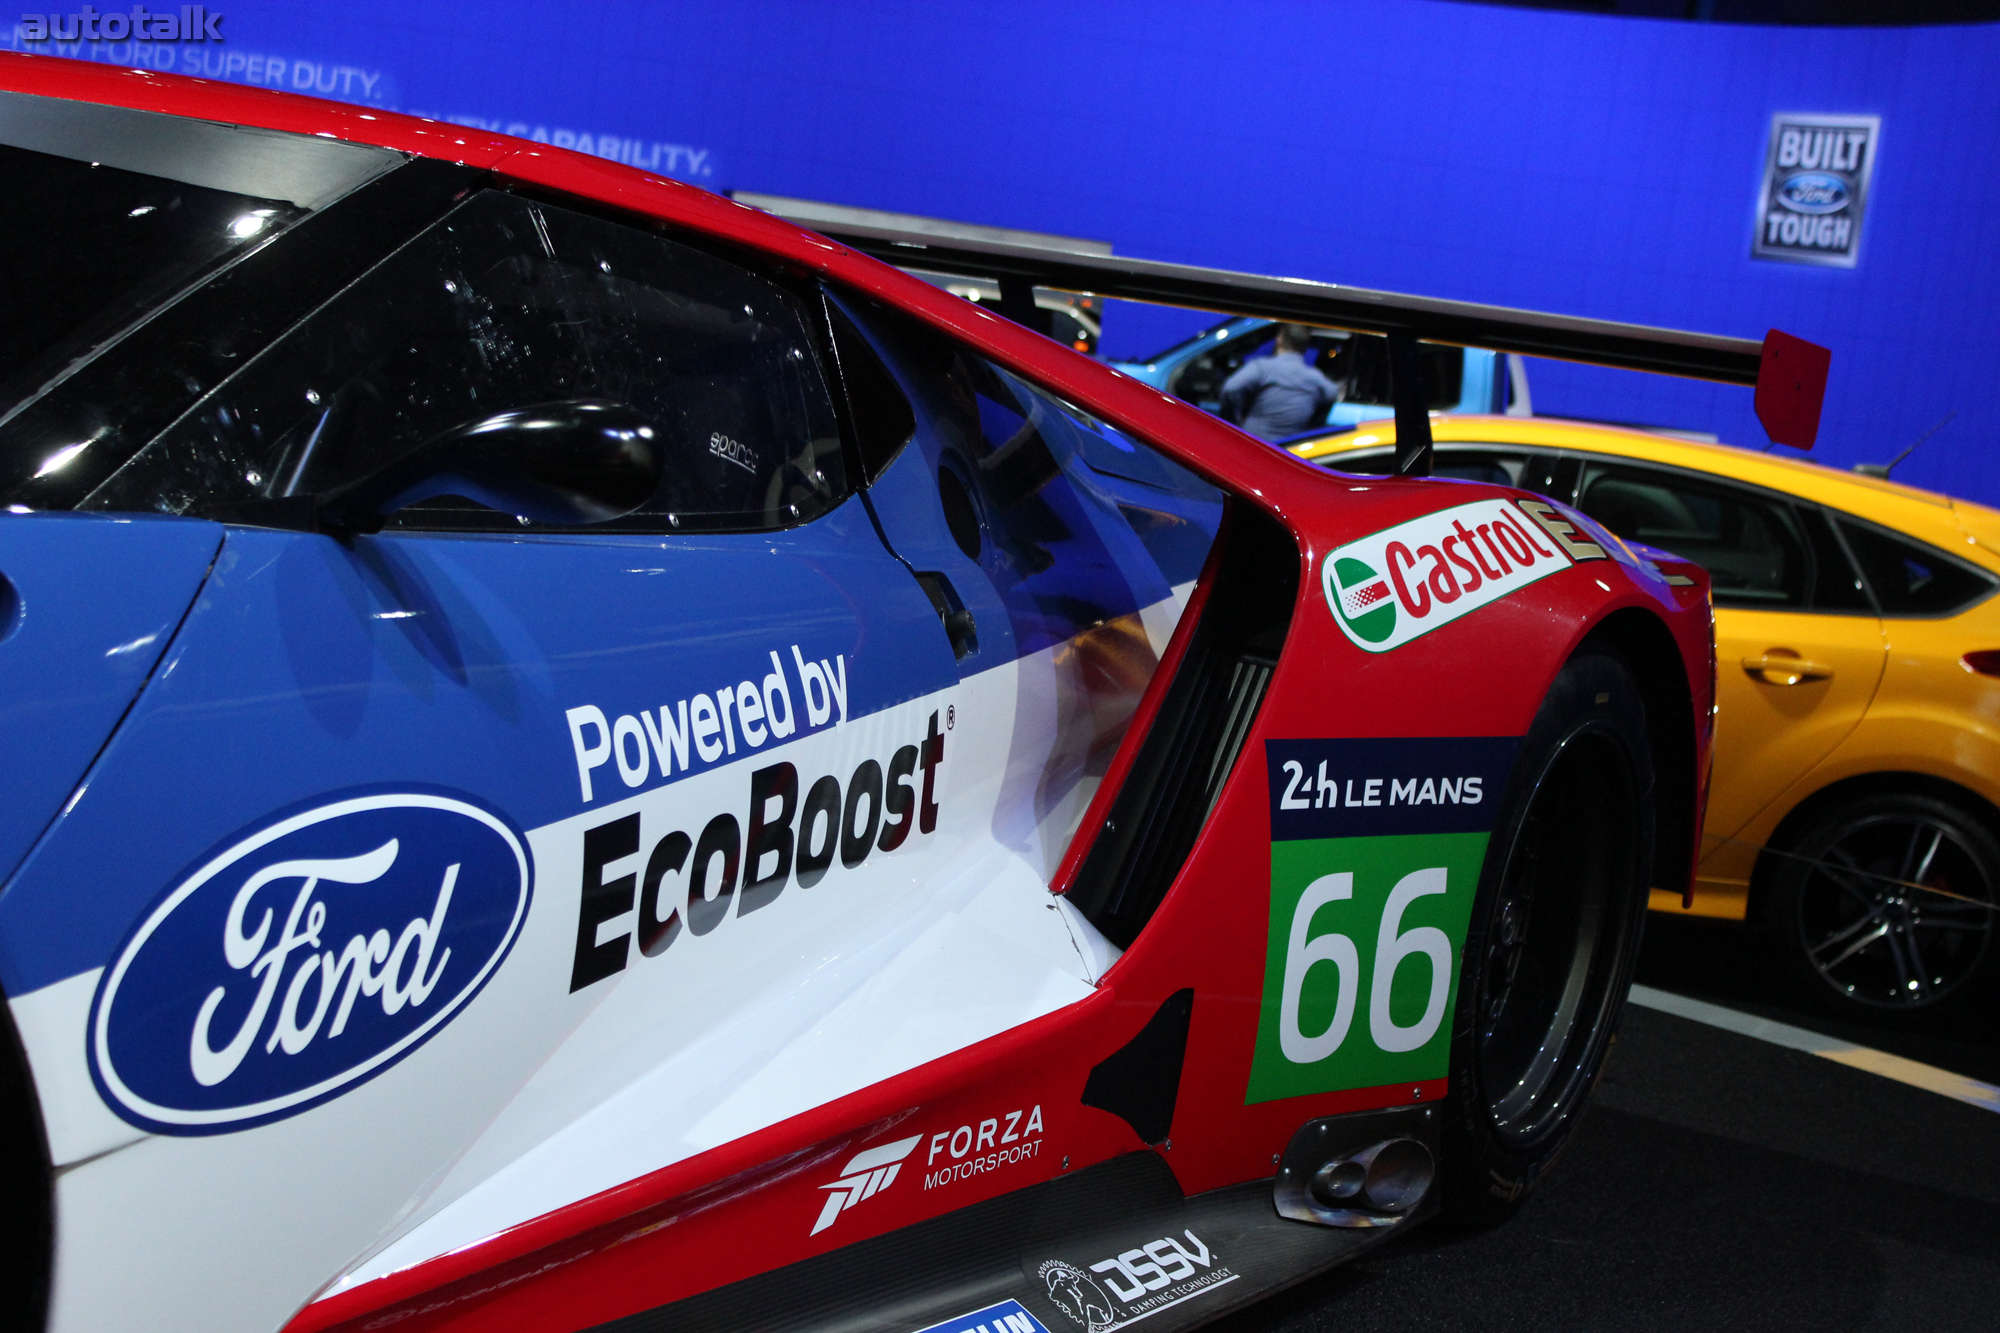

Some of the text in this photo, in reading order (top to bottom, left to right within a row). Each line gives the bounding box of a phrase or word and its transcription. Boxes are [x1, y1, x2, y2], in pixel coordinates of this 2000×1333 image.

[182, 47, 286, 86] SUPER
[292, 59, 383, 99] DUTY.
[1777, 130, 1866, 171] BUILT
[1767, 213, 1851, 249] TOUGH
[1384, 507, 1555, 619] Castrol
[566, 644, 847, 803] Powered by
[1279, 759, 1484, 810] 24h LE MANS
[189, 837, 463, 1087] Ford
[1279, 866, 1453, 1065] 66
[927, 1104, 1045, 1166] FORZA
[923, 1139, 1043, 1191] MOTORSPORT
[1129, 1266, 1234, 1315] DAMPING TECHNOLOGY
